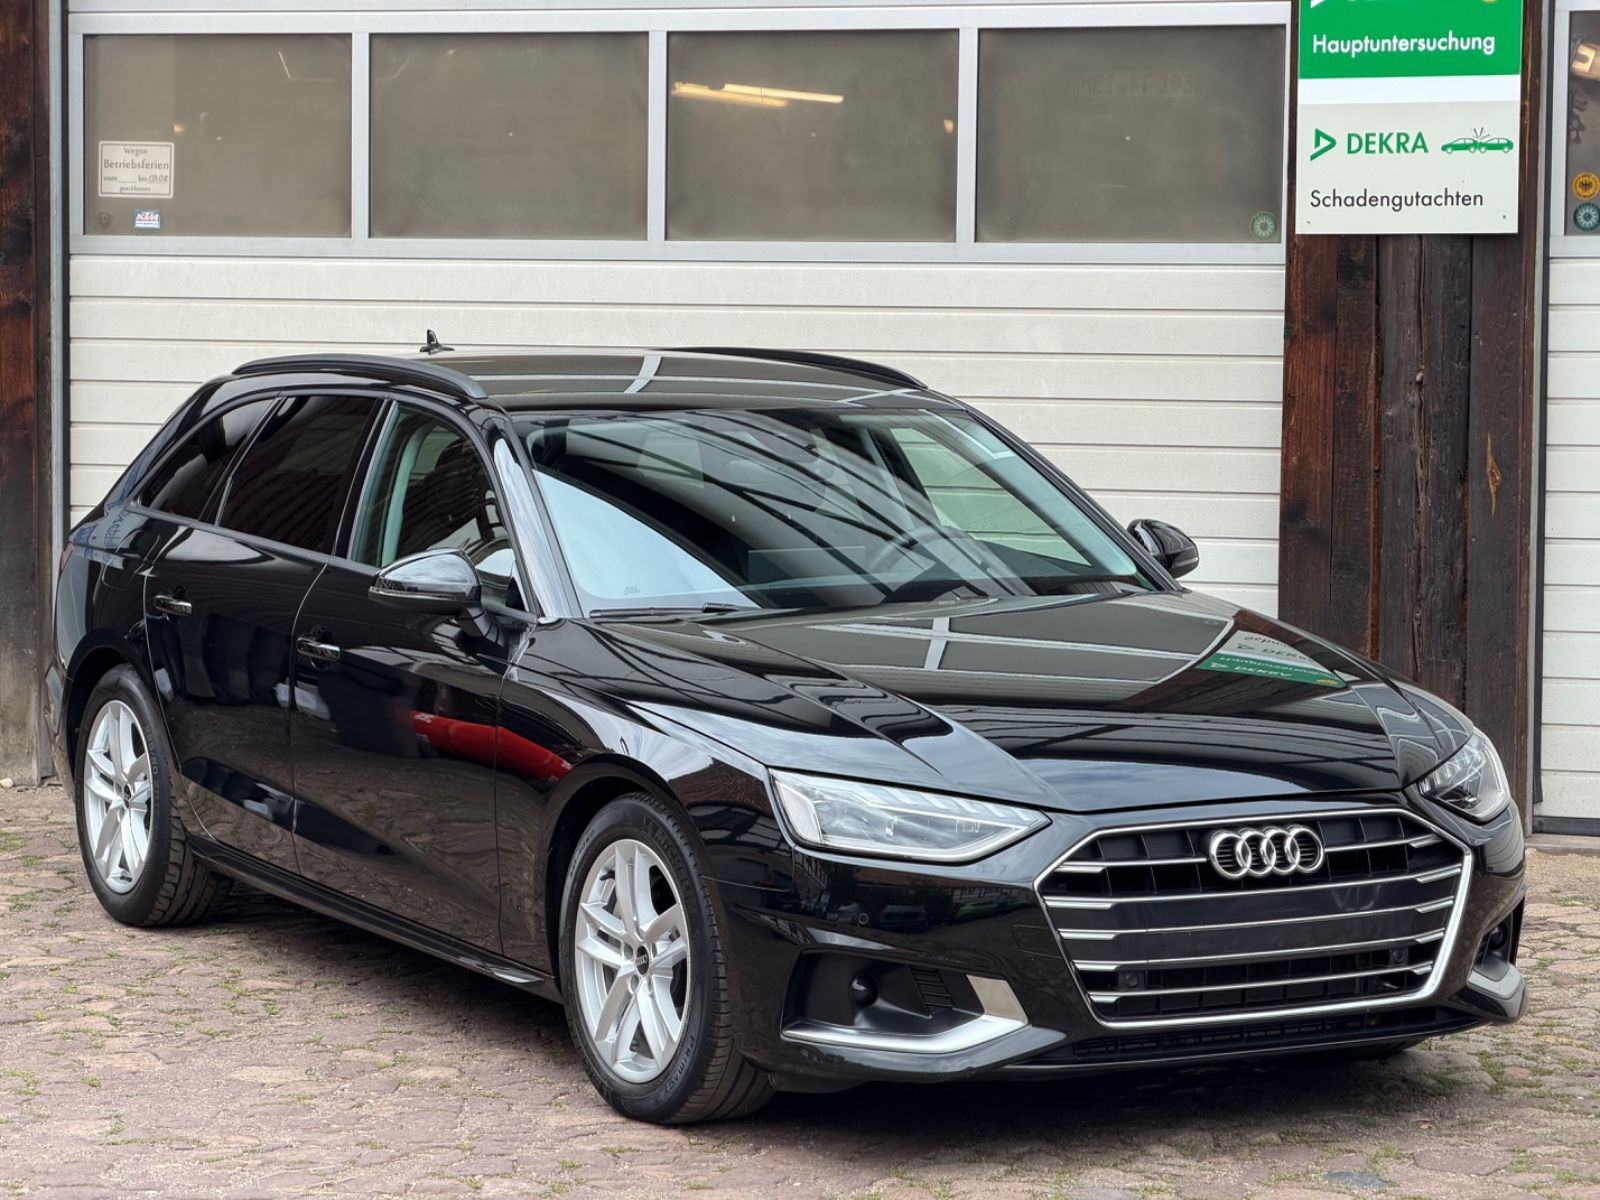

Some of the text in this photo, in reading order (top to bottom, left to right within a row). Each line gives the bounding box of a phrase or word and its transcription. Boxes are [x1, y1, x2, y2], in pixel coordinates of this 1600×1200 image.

[1312, 30, 1495, 58] Hauptuntersuchung
[124, 148, 148, 156] Wegen
[1347, 131, 1429, 154] DEKRA
[104, 159, 169, 169] Betriebsferien
[1310, 188, 1484, 212] Schadengutachten
